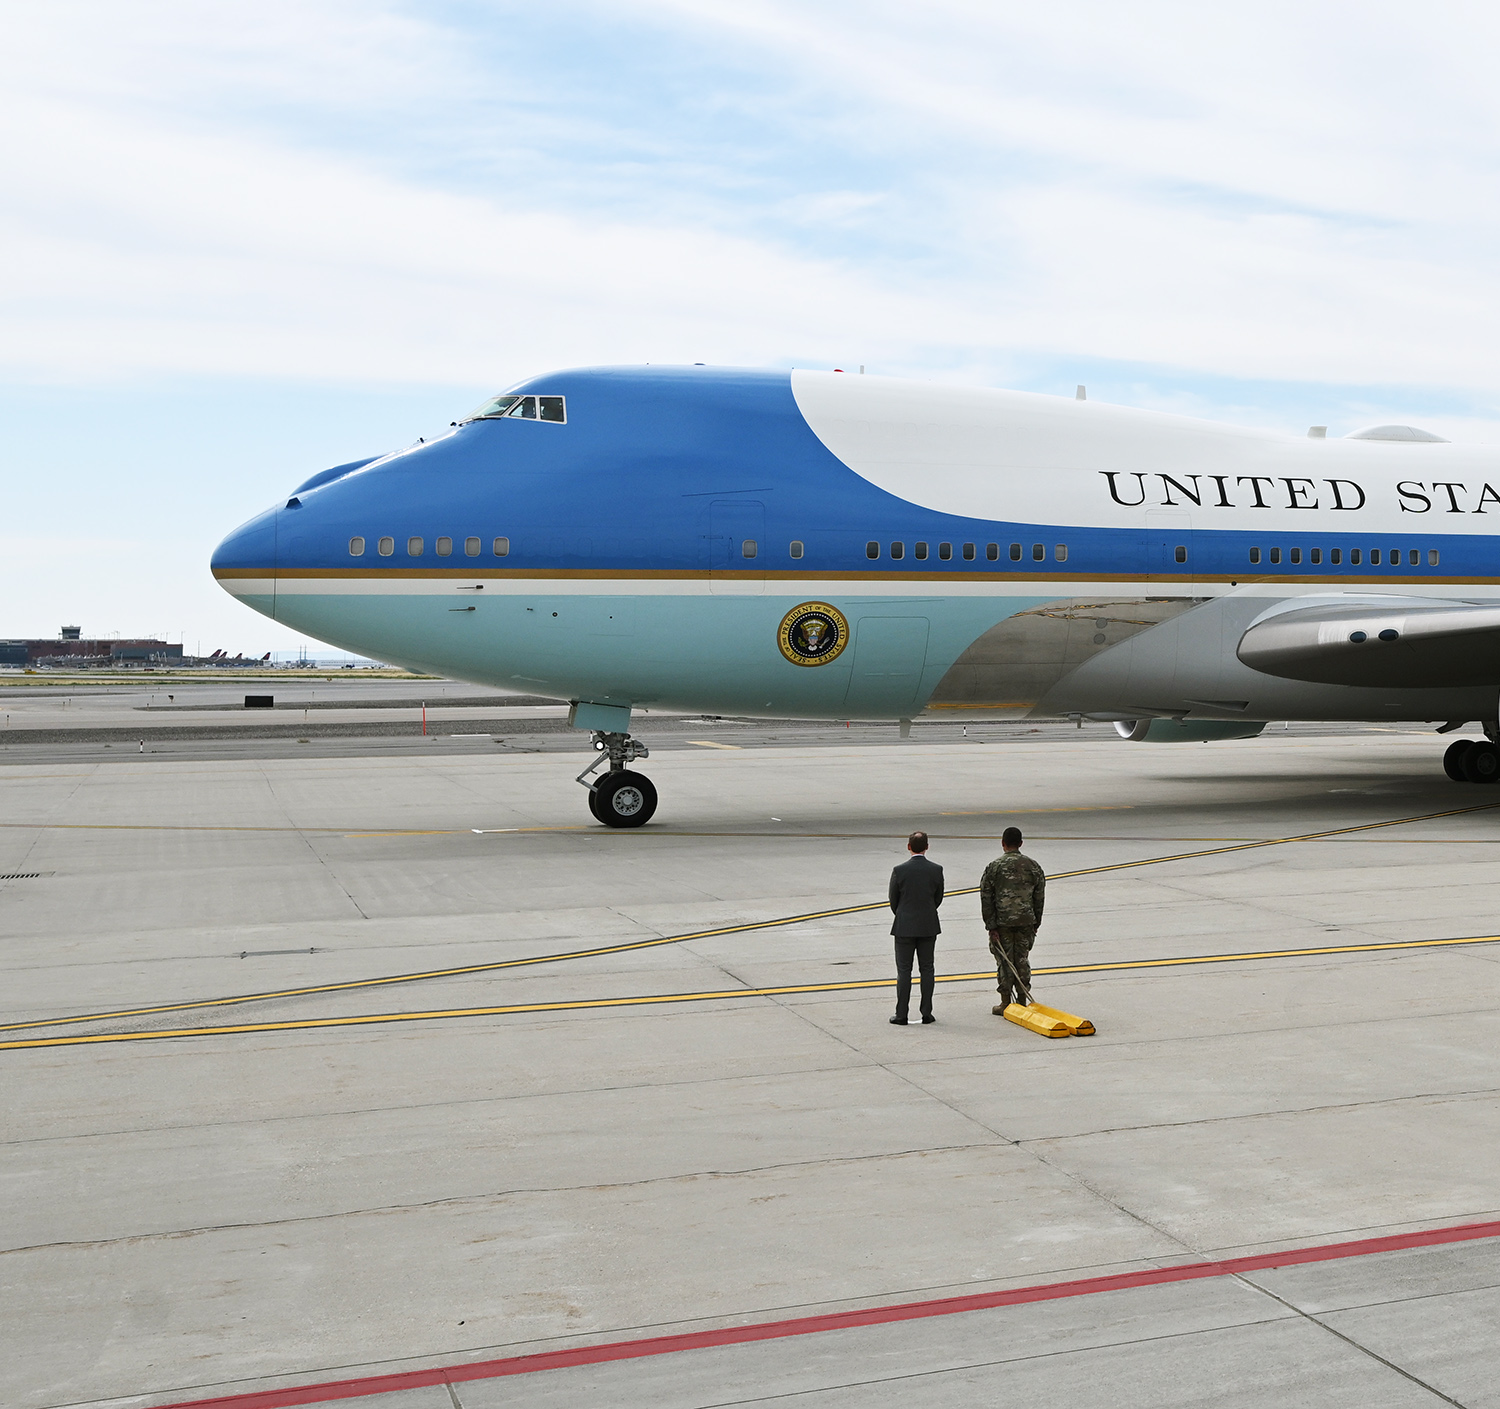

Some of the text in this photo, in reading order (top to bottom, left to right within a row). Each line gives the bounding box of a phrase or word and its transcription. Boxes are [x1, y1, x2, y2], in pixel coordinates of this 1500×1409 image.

[1099, 472, 1365, 510] UNITED
[782, 605, 813, 635] PRESIDENT
[832, 613, 846, 640] UNITED
[791, 653, 807, 663] SEAL
[818, 644, 842, 662] STATES
